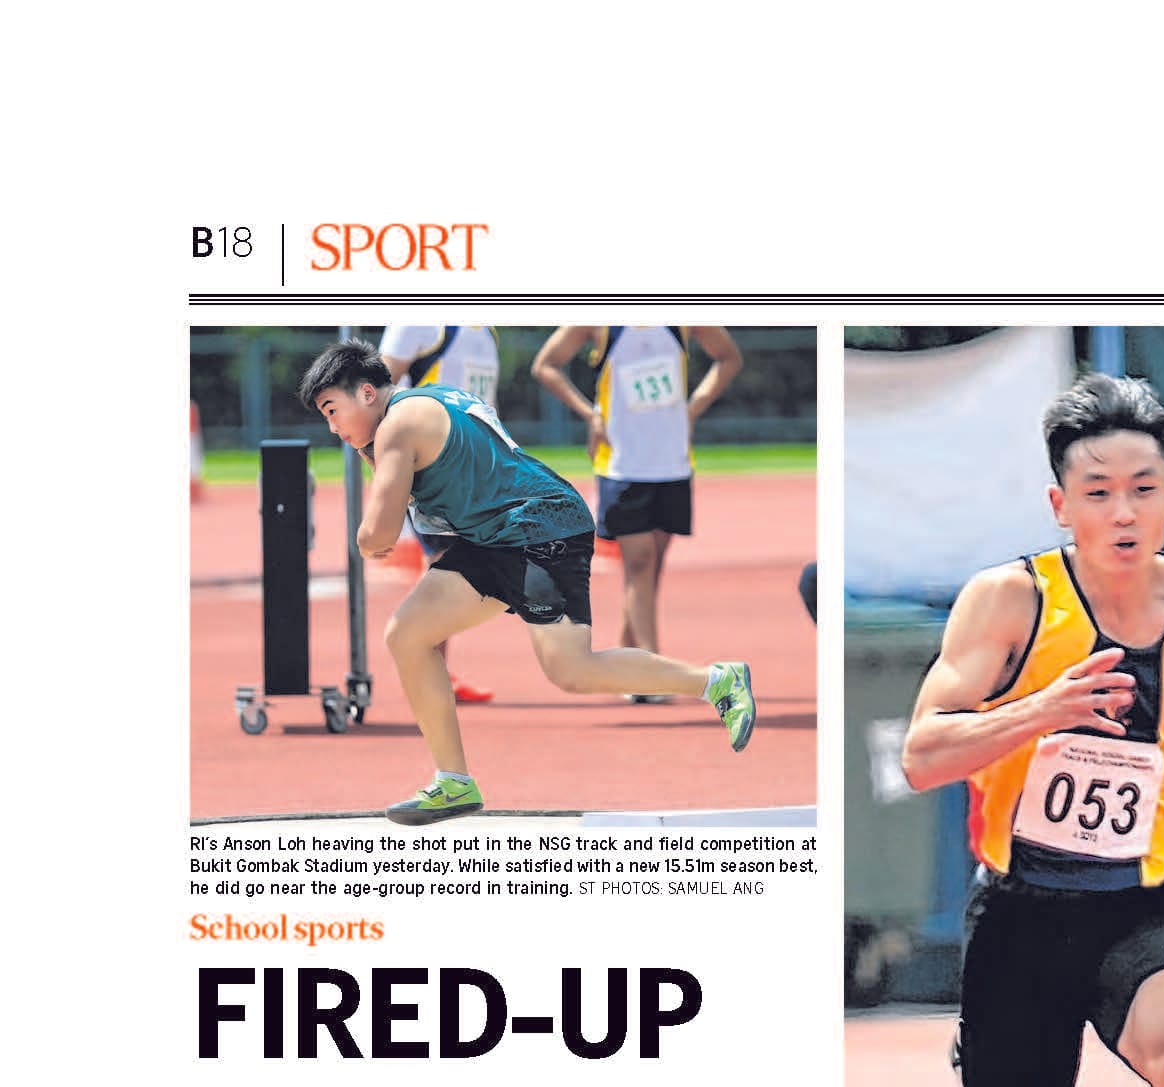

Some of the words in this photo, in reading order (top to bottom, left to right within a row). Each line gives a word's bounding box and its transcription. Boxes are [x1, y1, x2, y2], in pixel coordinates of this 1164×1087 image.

[192, 226, 253, 258] B18
[311, 223, 489, 271] SPORT
[633, 373, 673, 402] 131
[1044, 771, 1141, 835] 053
[190, 858, 232, 873] Bukit
[236, 858, 300, 873] Gombak
[304, 858, 368, 873] Stadium
[372, 858, 454, 876] yesterday.
[458, 858, 500, 873] While
[505, 858, 573, 873] satisfied
[576, 858, 611, 873] with
[615, 861, 624, 873] a
[629, 861, 661, 873] new
[664, 858, 715, 873] 15.51m
[720, 861, 775, 873] season
[779, 858, 818, 875] best,
[190, 880, 209, 895] he
[215, 880, 240, 895] did
[245, 883, 265, 898] go
[270, 883, 306, 895] near
[310, 880, 337, 895] the
[343, 883, 425, 898] age-group
[430, 880, 481, 895] record
[487, 880, 501, 895] in
[506, 880, 573, 898] training.
[579, 881, 596, 895] ST
[602, 881, 662, 895] PHOTOS:
[668, 881, 728, 895] SAMUEL
[732, 881, 765, 895] ANG
[190, 913, 287, 941] School
[293, 918, 384, 947] sports
[198, 967, 703, 1060] FIRED-UP
